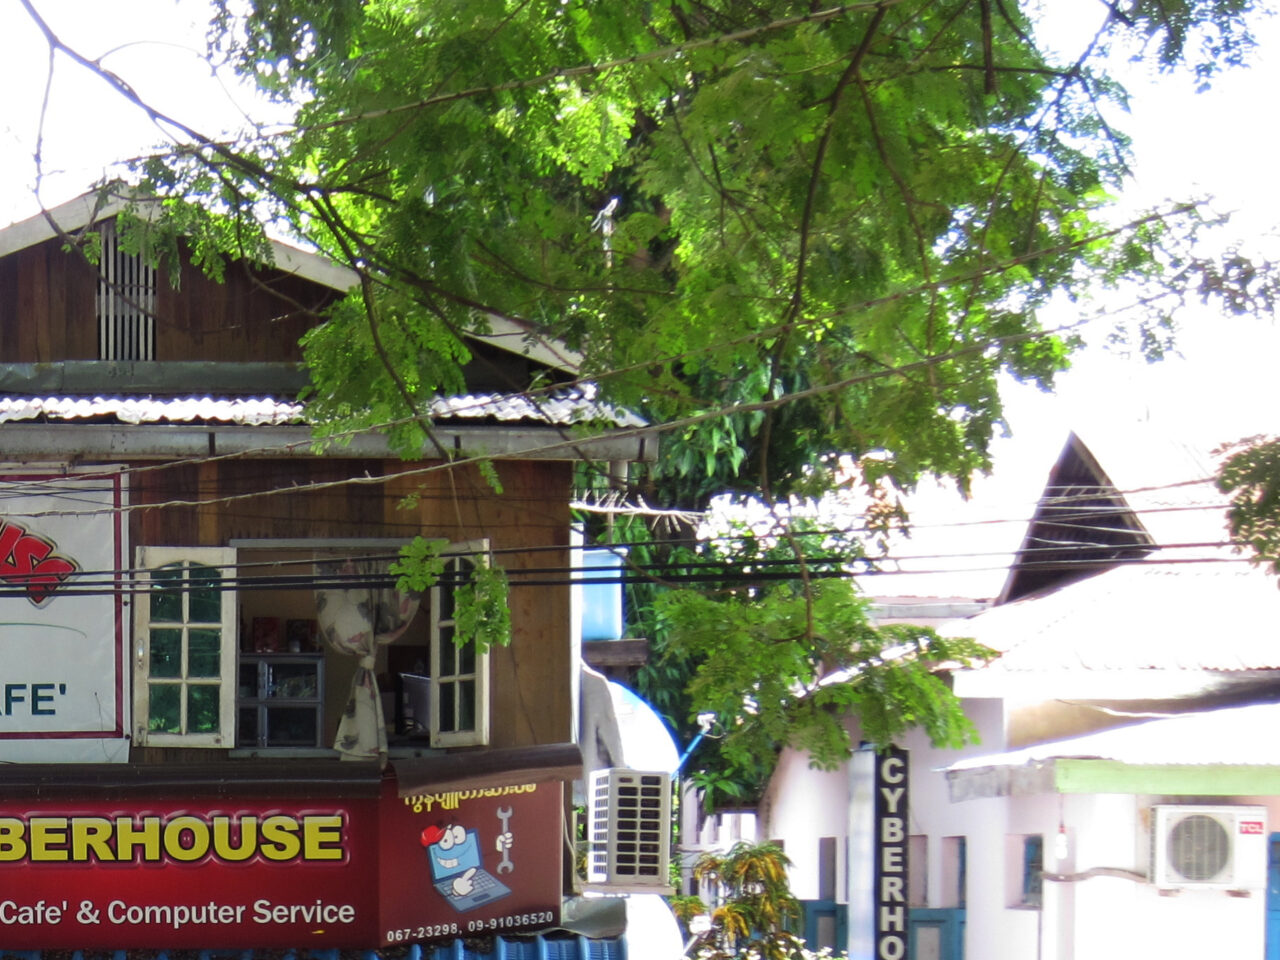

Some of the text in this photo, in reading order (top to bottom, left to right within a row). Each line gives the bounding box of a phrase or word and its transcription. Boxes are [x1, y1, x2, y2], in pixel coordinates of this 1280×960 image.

[76, 900, 100, 925] &
[107, 900, 246, 929] Computer
[252, 899, 356, 925] Service
[468, 911, 554, 933] 09-91036520
